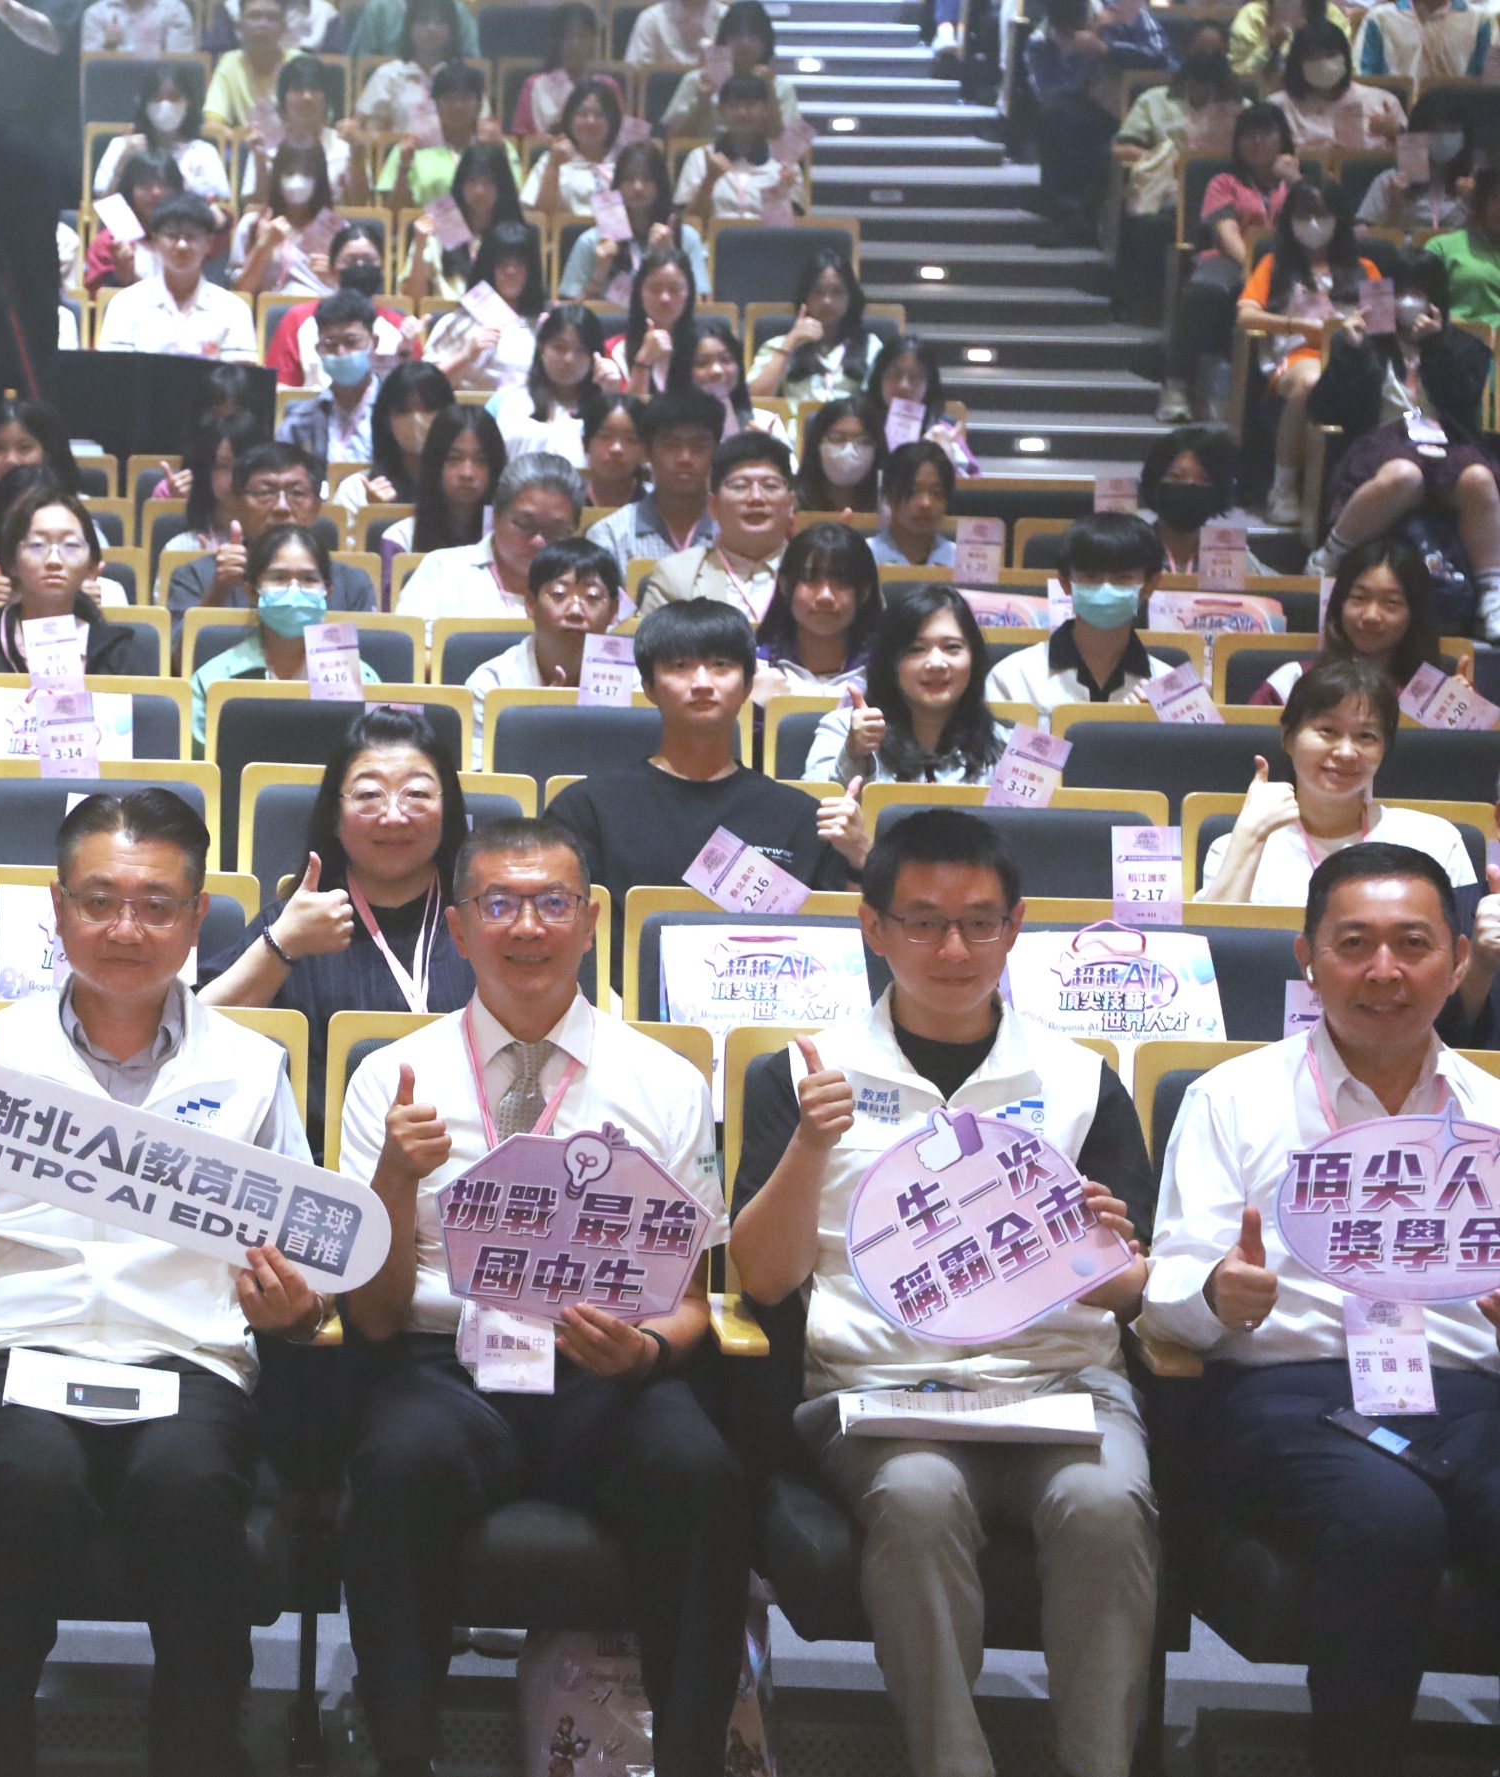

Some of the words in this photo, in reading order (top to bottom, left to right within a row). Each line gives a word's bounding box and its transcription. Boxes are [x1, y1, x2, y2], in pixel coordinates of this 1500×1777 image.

[323, 672, 348, 683] 4-16
[593, 685, 618, 696] 4-17
[1447, 702, 1468, 726] 4-20
[55, 747, 82, 760] 3-14
[1007, 780, 1037, 799] 3-17
[744, 877, 769, 907] 2-16
[1132, 889, 1164, 901] 2-17
[725, 953, 814, 981] 超越AI
[1071, 961, 1161, 990] 超越AI
[1059, 991, 1147, 1011] 頂尖技藝
[1101, 1012, 1190, 1032] 世界人才
[860, 1087, 900, 1104] 教育局
[1287, 1150, 1500, 1213] 頂尖人
[850, 1136, 1058, 1258] 一生一次
[105, 1184, 157, 1215] AI
[168, 1201, 269, 1249] EDU
[295, 1196, 355, 1236] 全球
[284, 1227, 345, 1267] 首推
[889, 1180, 1097, 1327] 稱霸全市
[1322, 1217, 1500, 1274] 獎學金
[468, 1245, 646, 1312] 國中生
[486, 1334, 546, 1351] 重慶國中
[1355, 1357, 1424, 1374] 張國振
